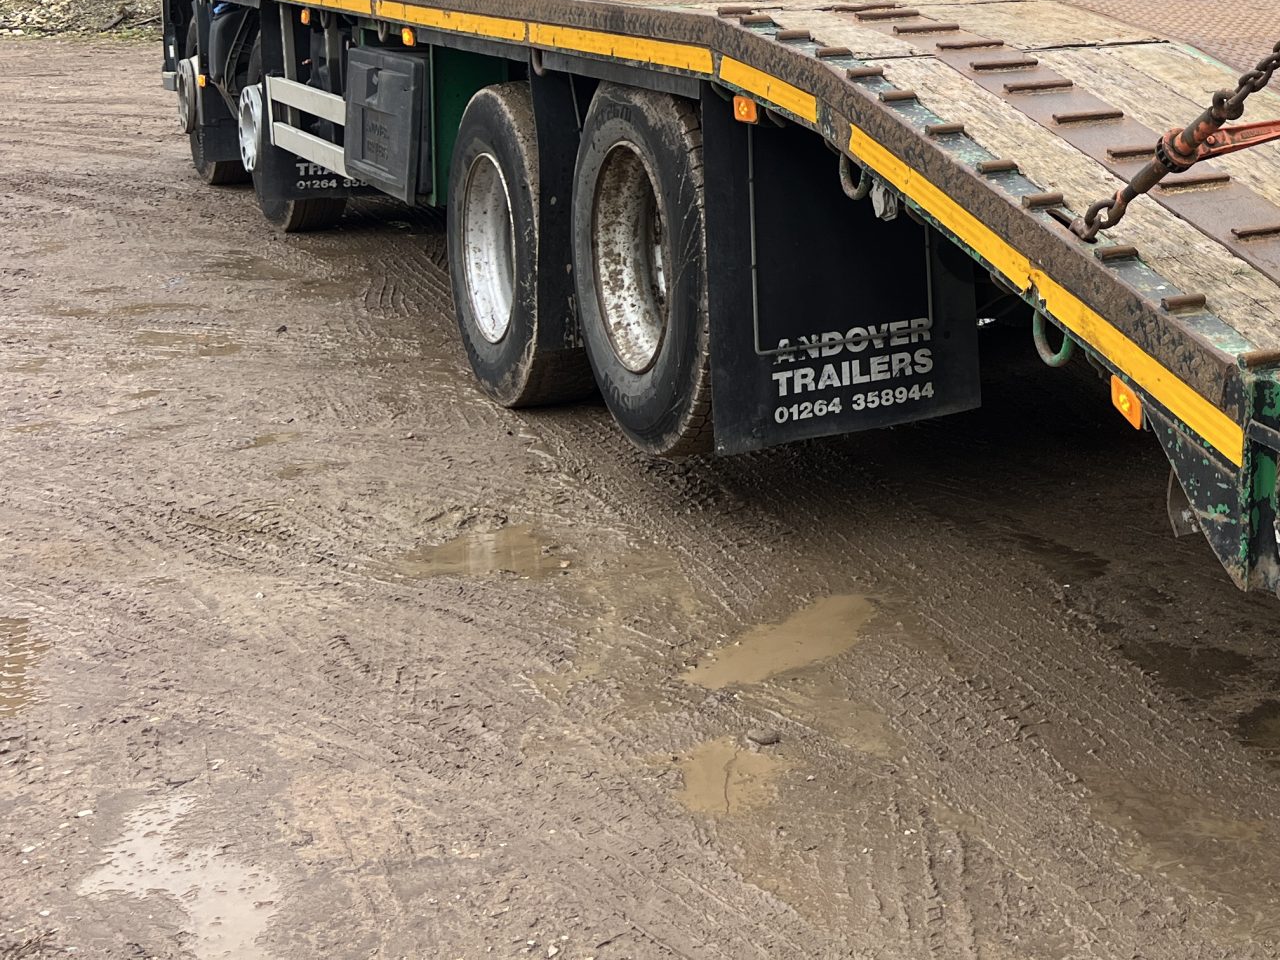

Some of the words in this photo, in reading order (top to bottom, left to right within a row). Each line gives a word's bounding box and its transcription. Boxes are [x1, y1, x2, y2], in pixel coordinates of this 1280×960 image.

[296, 179, 338, 190] 01264
[773, 317, 931, 366] ANDOVER
[771, 347, 934, 397] TRAILERS
[774, 397, 843, 424] 01264
[851, 381, 935, 411] 358944
